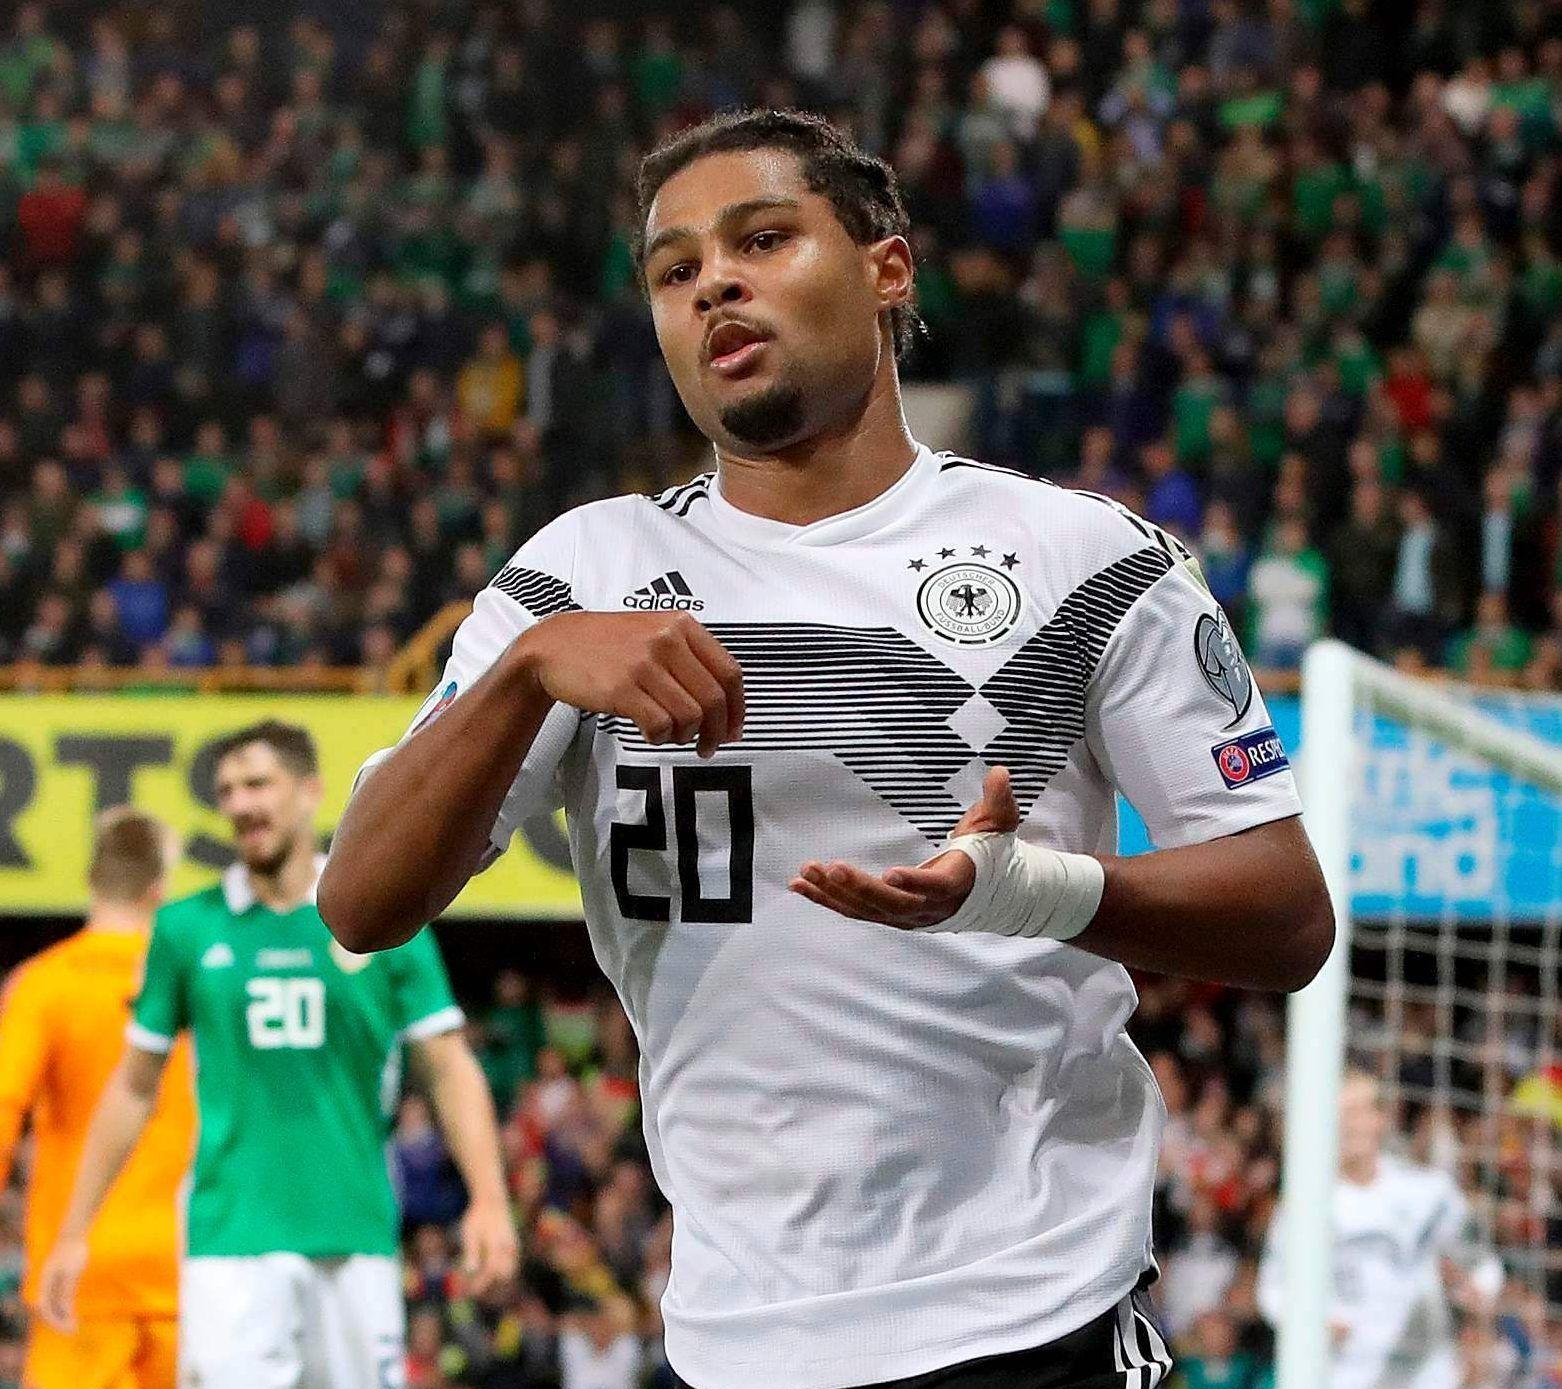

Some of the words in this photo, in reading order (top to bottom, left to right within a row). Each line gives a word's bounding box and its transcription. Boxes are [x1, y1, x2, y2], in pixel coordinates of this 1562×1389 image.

[937, 571, 996, 589] DEUTSCHER
[622, 594, 705, 612] adidas
[610, 764, 755, 924] 20
[245, 977, 327, 1050] 20
